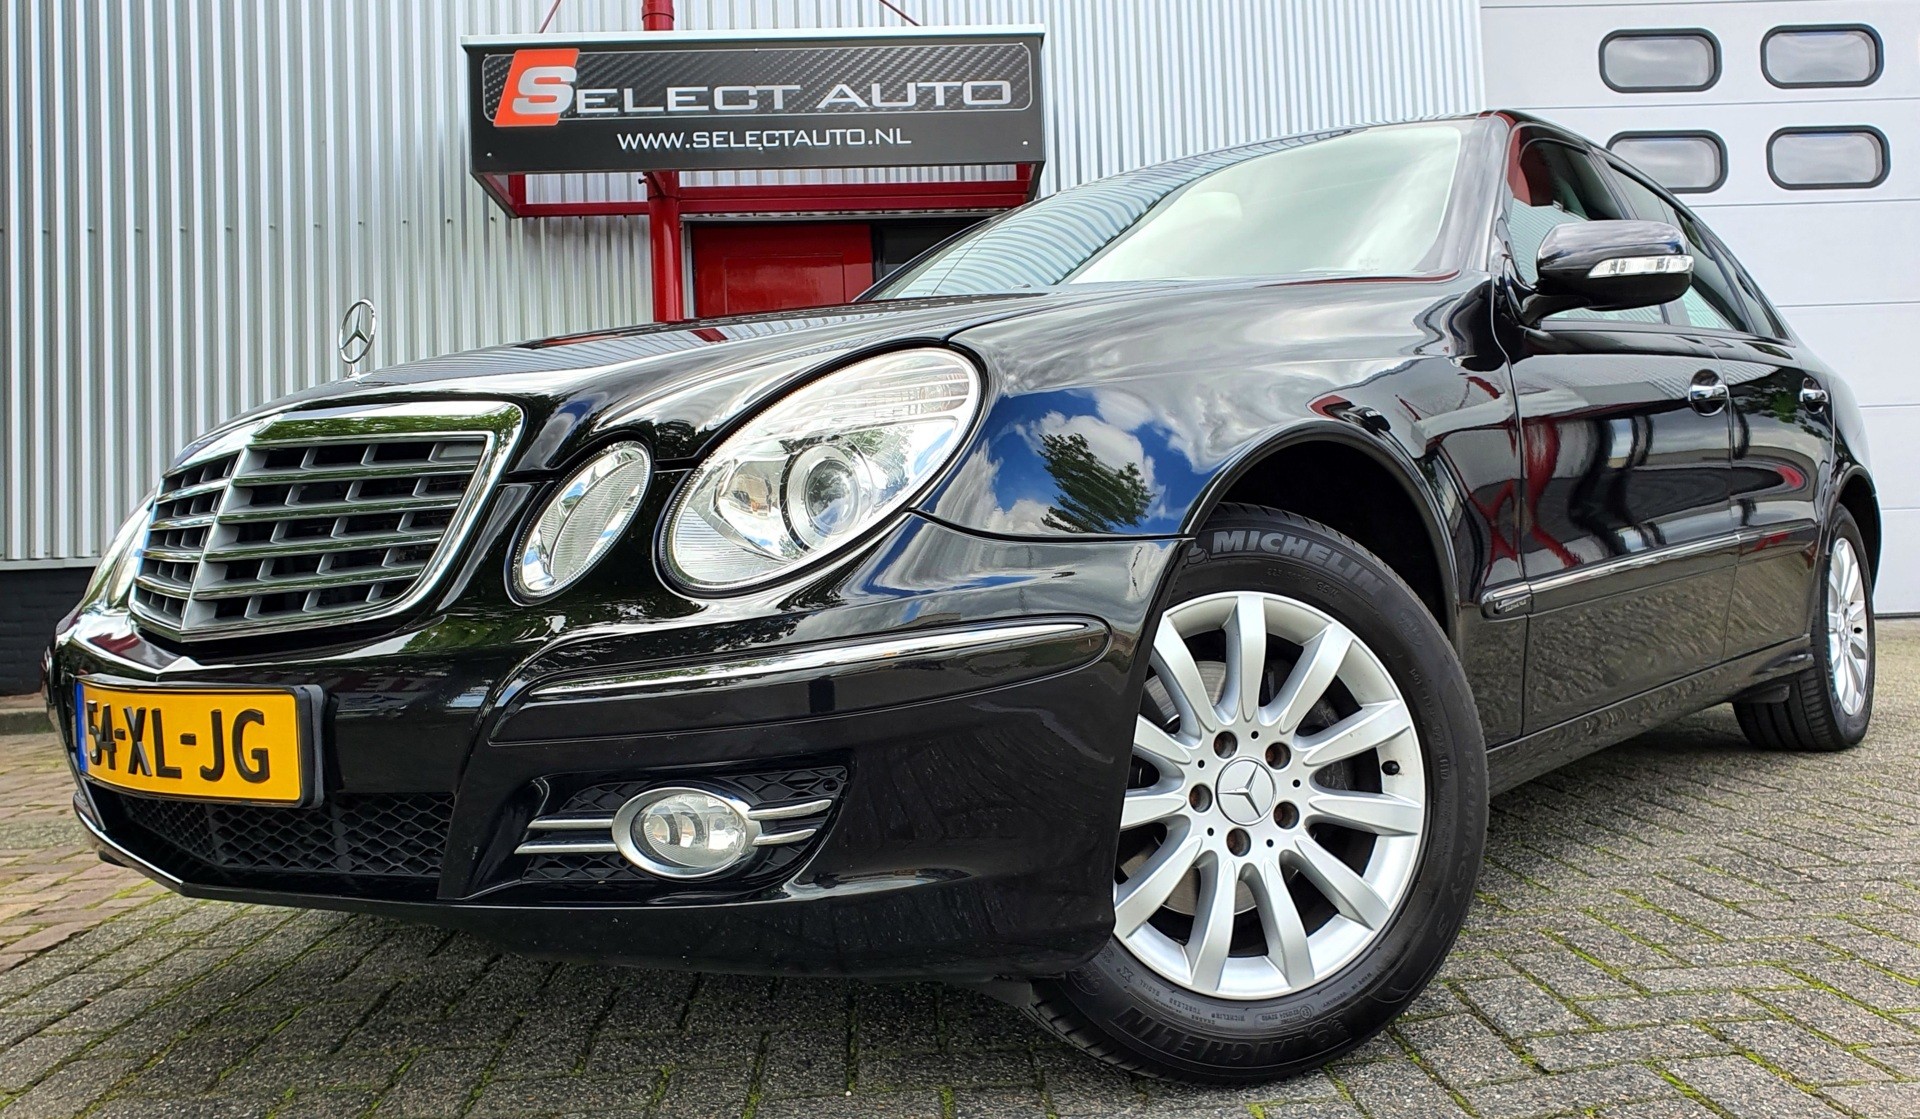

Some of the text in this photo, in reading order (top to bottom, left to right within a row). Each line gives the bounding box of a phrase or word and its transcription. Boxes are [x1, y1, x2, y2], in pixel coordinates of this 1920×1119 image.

[513, 65, 1012, 116] SELECT AUTO
[616, 127, 912, 152] WWW.SELECTAUTO.NL
[1211, 530, 1388, 596] MICHELIN
[86, 699, 271, 784] 54-XL-JG
